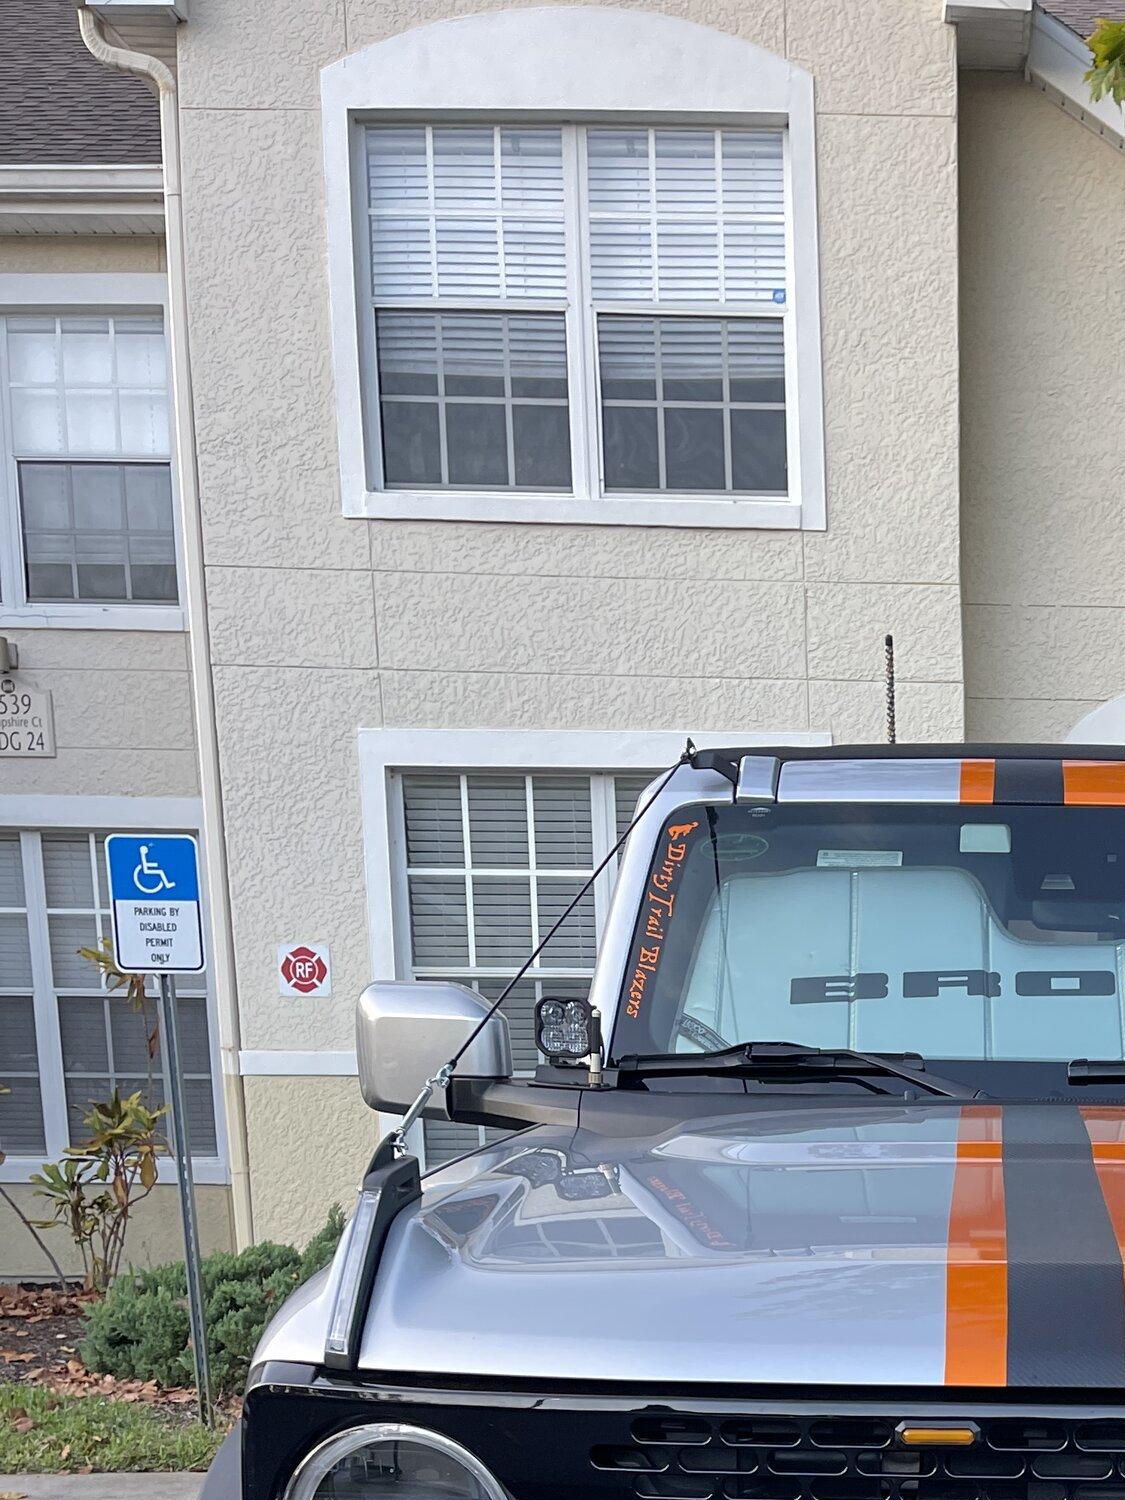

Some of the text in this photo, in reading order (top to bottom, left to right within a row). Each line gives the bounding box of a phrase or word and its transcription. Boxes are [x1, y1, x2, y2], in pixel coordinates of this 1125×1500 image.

[26, 731, 44, 751] 24
[133, 907, 180, 917] PARKING BY
[139, 922, 177, 932] DISABLED
[626, 843, 686, 1018] Dirty Trail Blazers
[145, 937, 173, 947] PERMIT
[150, 953, 171, 963] ONLY
[295, 961, 314, 979] RF
